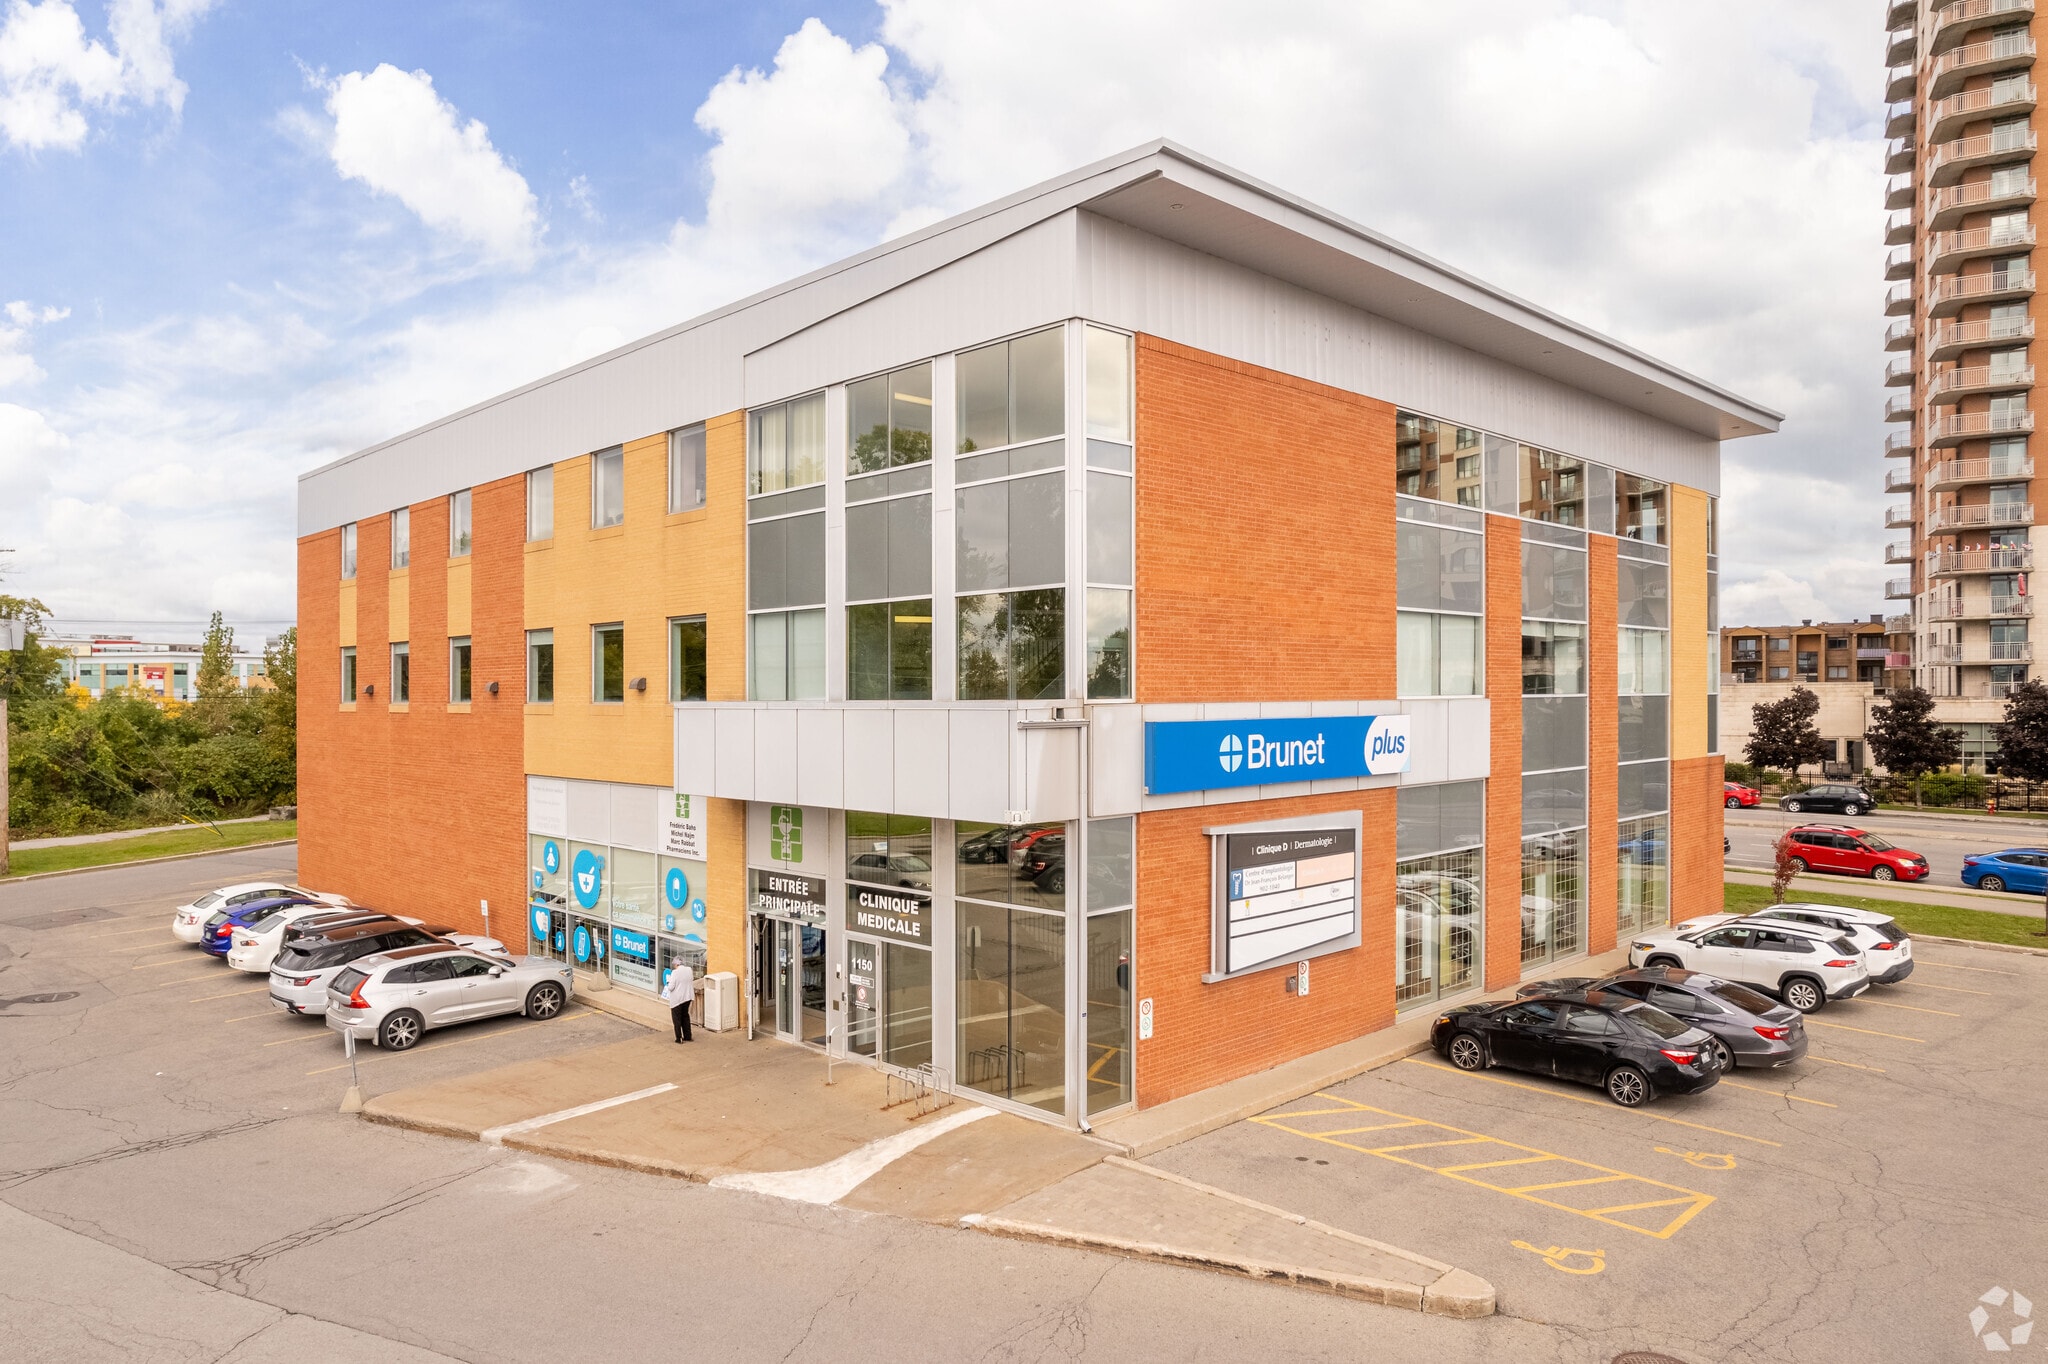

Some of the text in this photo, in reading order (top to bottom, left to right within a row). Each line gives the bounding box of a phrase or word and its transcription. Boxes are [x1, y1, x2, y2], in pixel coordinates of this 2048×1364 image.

[1247, 728, 1405, 769] Brunet plus
[666, 845, 691, 854] Pharmaciens
[1256, 836, 1333, 855] Clinique D Dermatologie
[1245, 869, 1260, 877] Centre
[769, 876, 809, 896] ENTRÉE
[759, 895, 820, 917] PRINCIPALE
[859, 892, 919, 915] CLINIQUE
[857, 915, 921, 937] MEDICALE
[622, 936, 646, 954] Brunet
[851, 957, 873, 972] 1150
